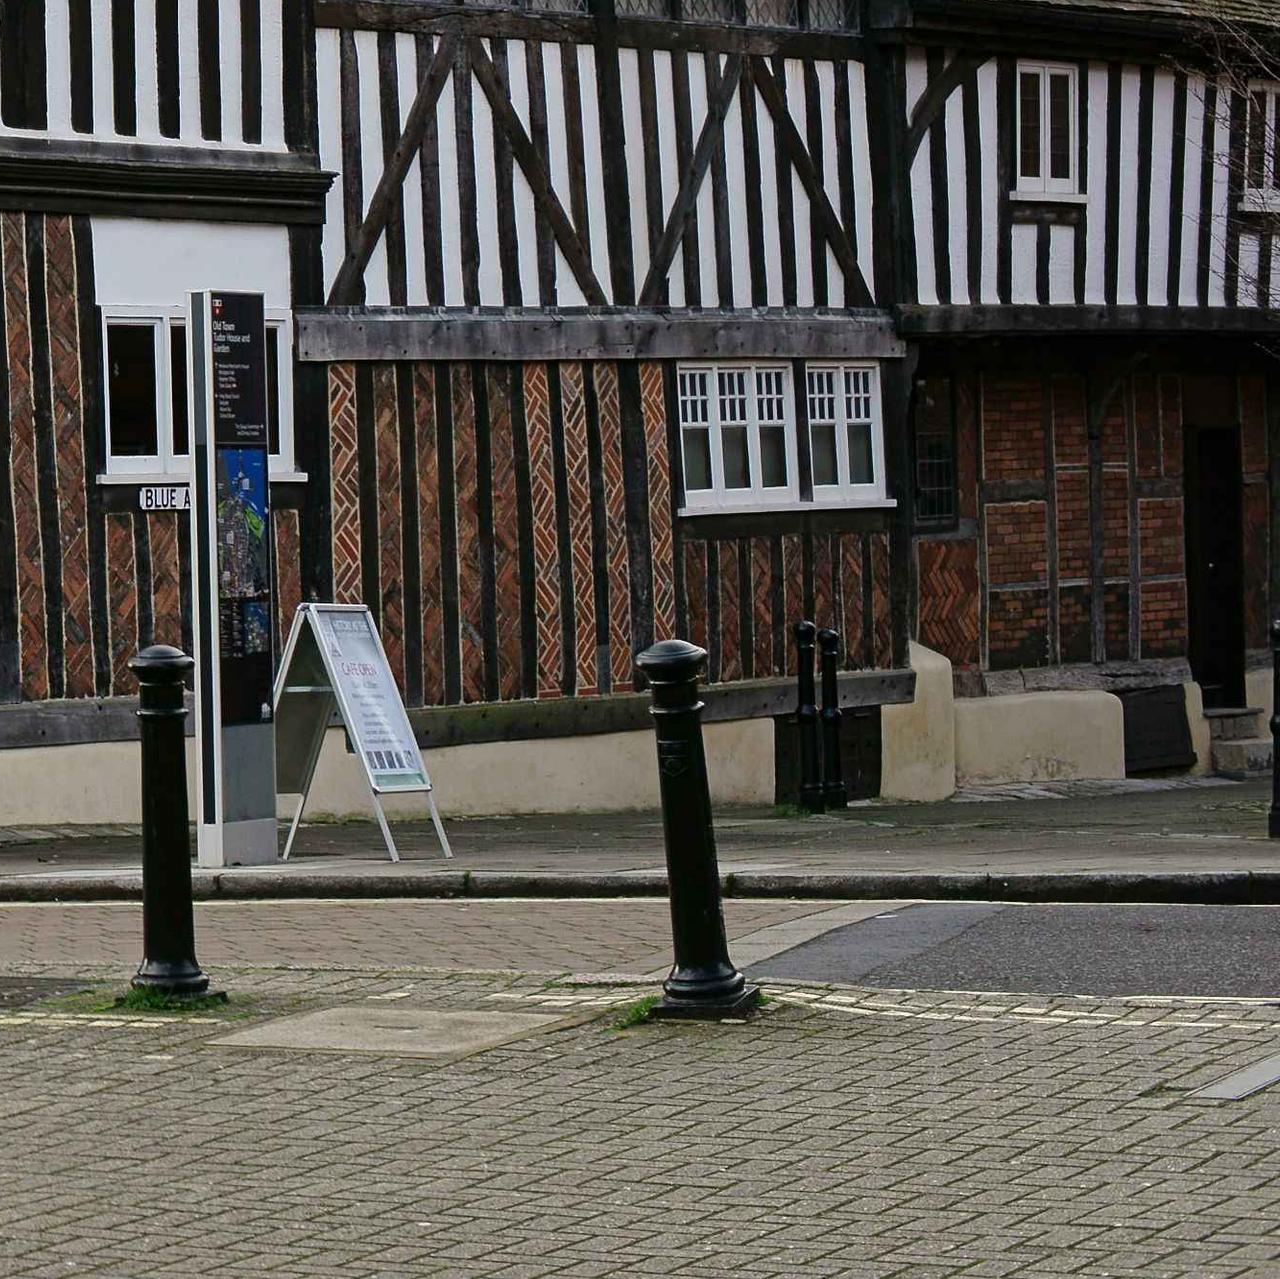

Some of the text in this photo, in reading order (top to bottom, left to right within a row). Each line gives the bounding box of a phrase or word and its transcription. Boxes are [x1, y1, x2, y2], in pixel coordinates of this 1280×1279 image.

[213, 320, 235, 331] Old Town
[213, 332, 251, 343] Tudor House and
[213, 342, 230, 353] Garden
[145, 488, 176, 508] BLUE
